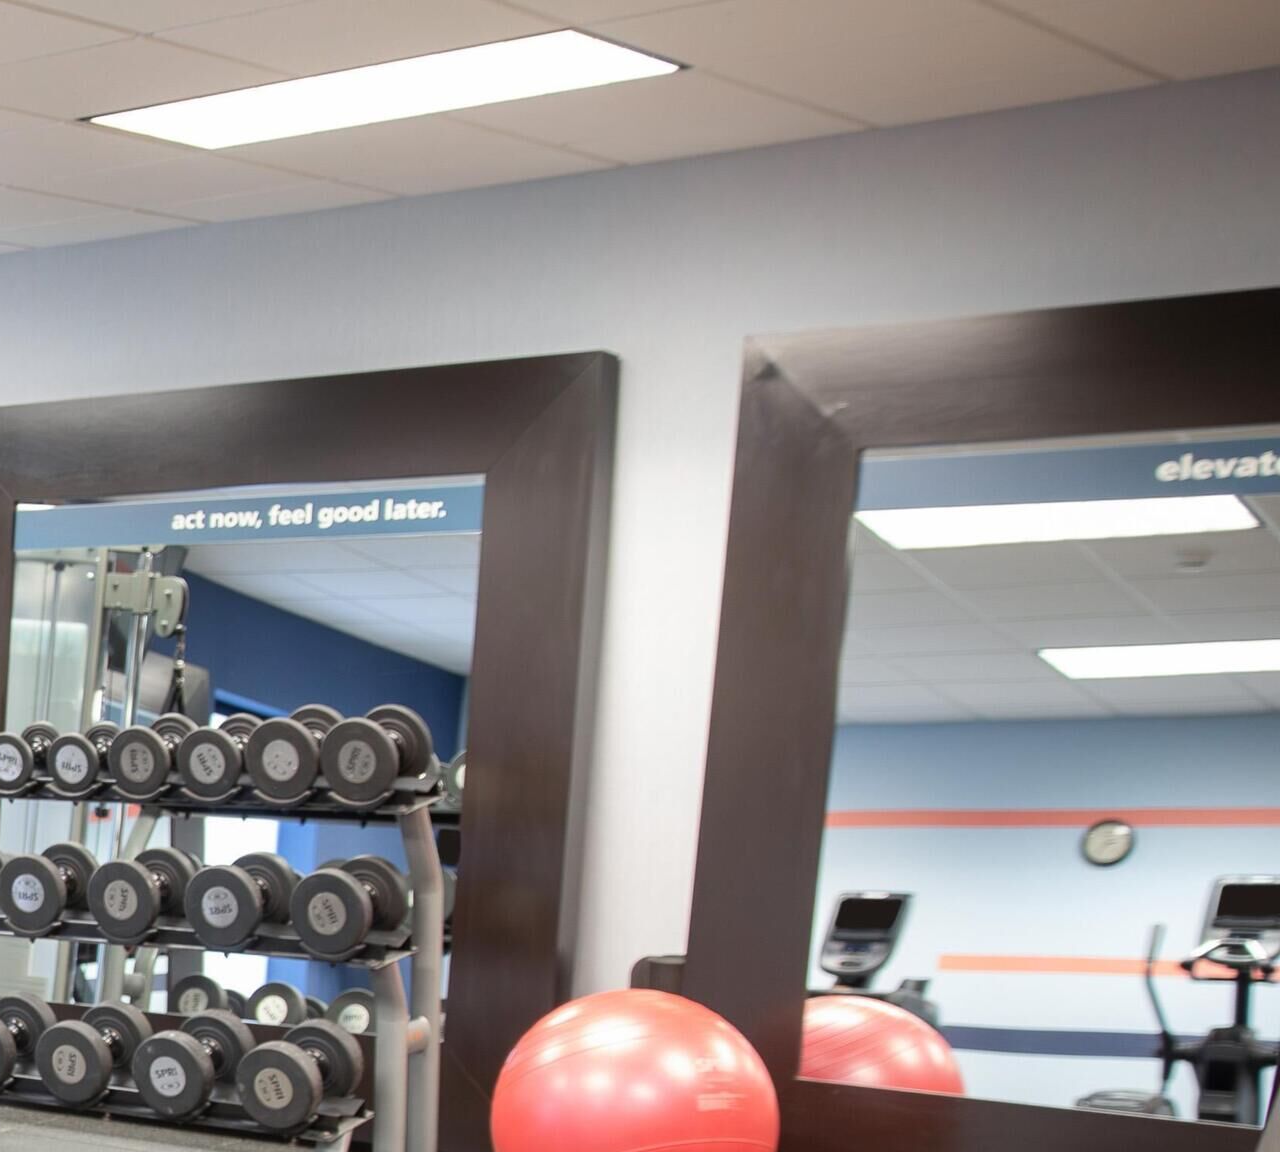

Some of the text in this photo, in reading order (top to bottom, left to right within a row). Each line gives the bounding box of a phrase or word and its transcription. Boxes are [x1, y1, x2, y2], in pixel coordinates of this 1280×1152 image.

[1154, 449, 1280, 482] elevat
[171, 498, 447, 530] act now, feel good later.
[60, 760, 83, 774] SPRI
[196, 752, 214, 777] SPRI
[17, 890, 40, 902] SPRI
[207, 903, 234, 916] SPRI
[320, 898, 338, 926] SPRI
[65, 1052, 78, 1078] SPRI
[154, 1066, 180, 1080] SPRI
[267, 1073, 285, 1101] SPRI
